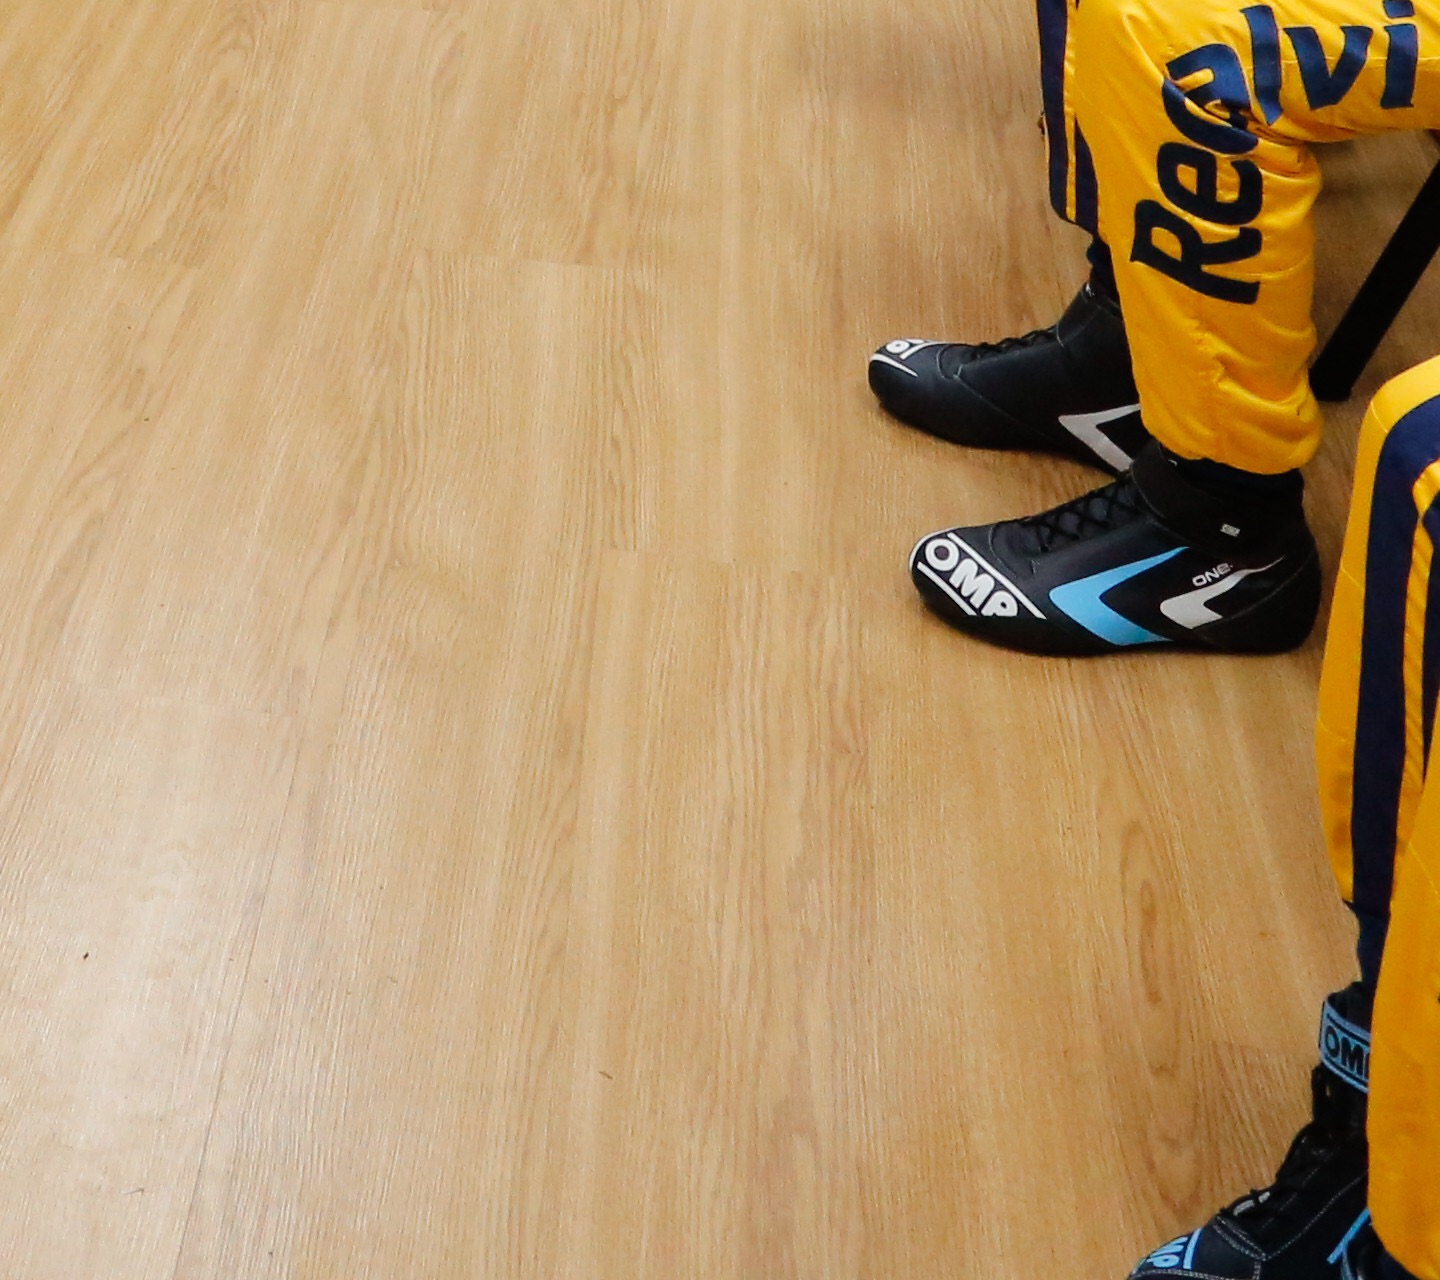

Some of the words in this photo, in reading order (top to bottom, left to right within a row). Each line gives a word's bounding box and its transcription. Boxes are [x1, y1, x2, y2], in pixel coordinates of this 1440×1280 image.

[924, 538, 1019, 618] OMP
[1191, 562, 1234, 588] ONE
[1323, 1023, 1368, 1079] OM
